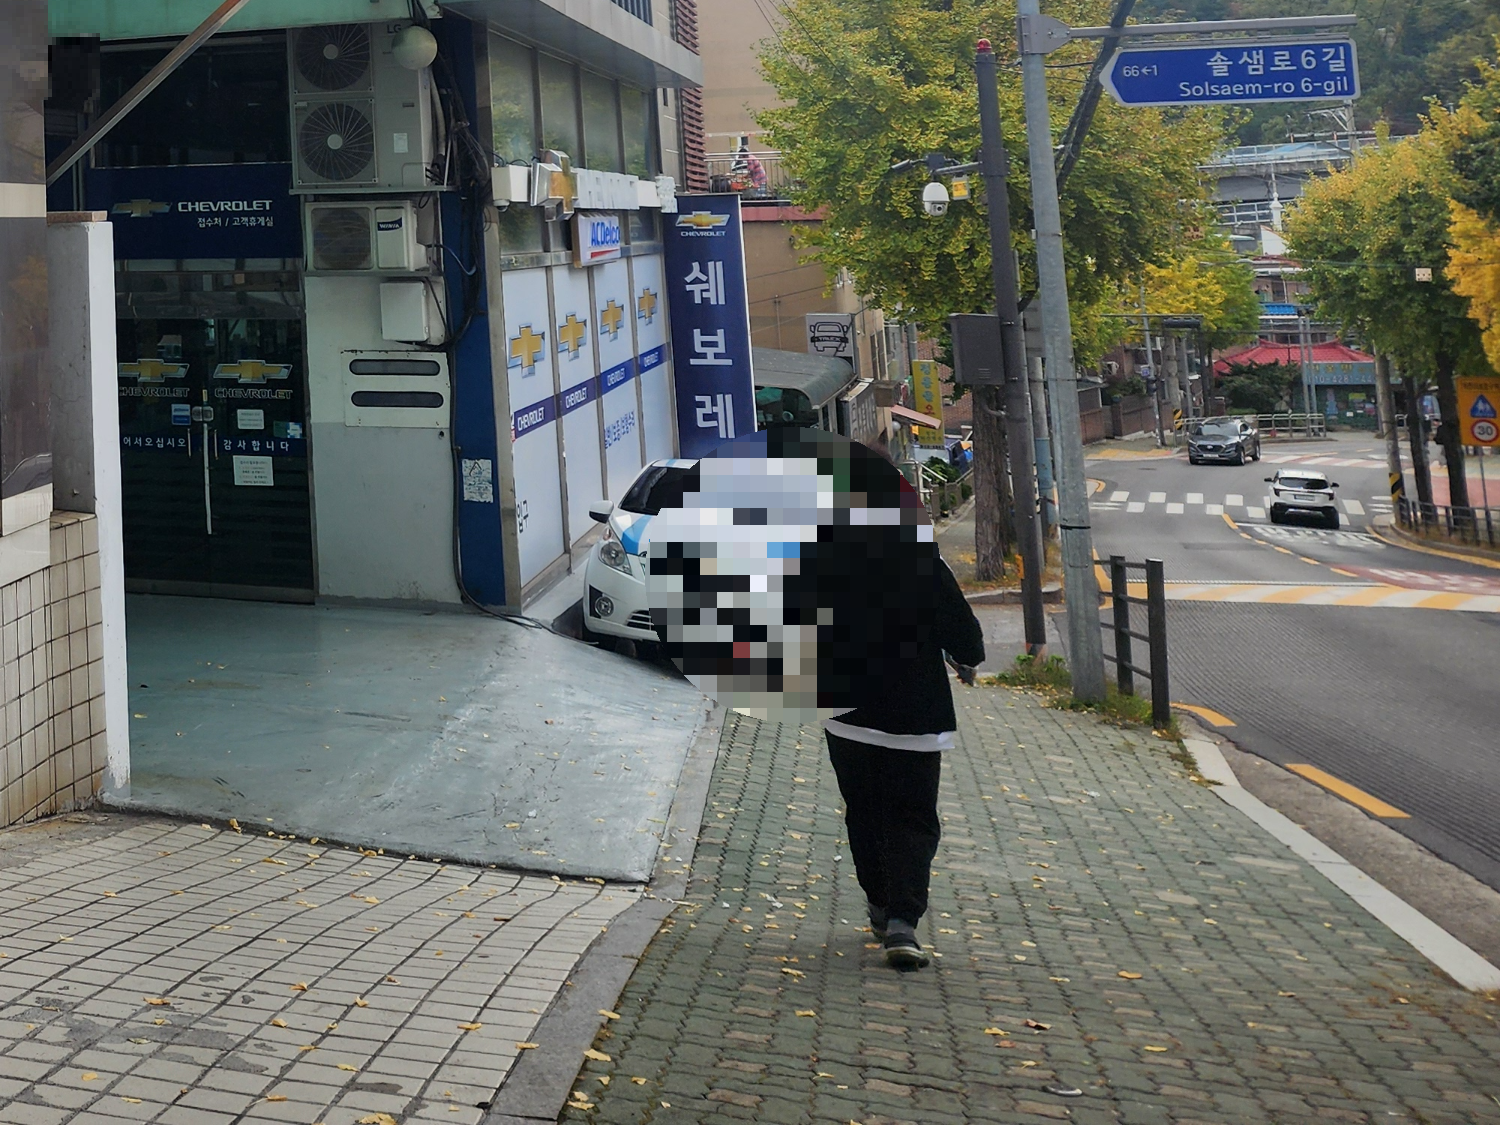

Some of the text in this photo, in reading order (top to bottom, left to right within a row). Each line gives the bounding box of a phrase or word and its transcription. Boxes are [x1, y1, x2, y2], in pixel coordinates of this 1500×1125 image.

[386, 24, 402, 34] LG
[1206, 45, 1347, 77] 솔샘로6길
[1179, 76, 1348, 98] Solsaem-ro 6-gil
[177, 199, 273, 213] CHEVROLET
[197, 216, 223, 228] 접수처
[232, 216, 274, 228] 고객휴게실
[590, 220, 620, 247] ACDelco
[684, 259, 736, 440] 쉐보레
[214, 387, 294, 400] CHEVROLET
[517, 406, 545, 431] CHEVROLET
[1477, 425, 1493, 436] 30
[123, 435, 187, 448] 어서오십시오
[223, 439, 290, 452] 감사합니다
